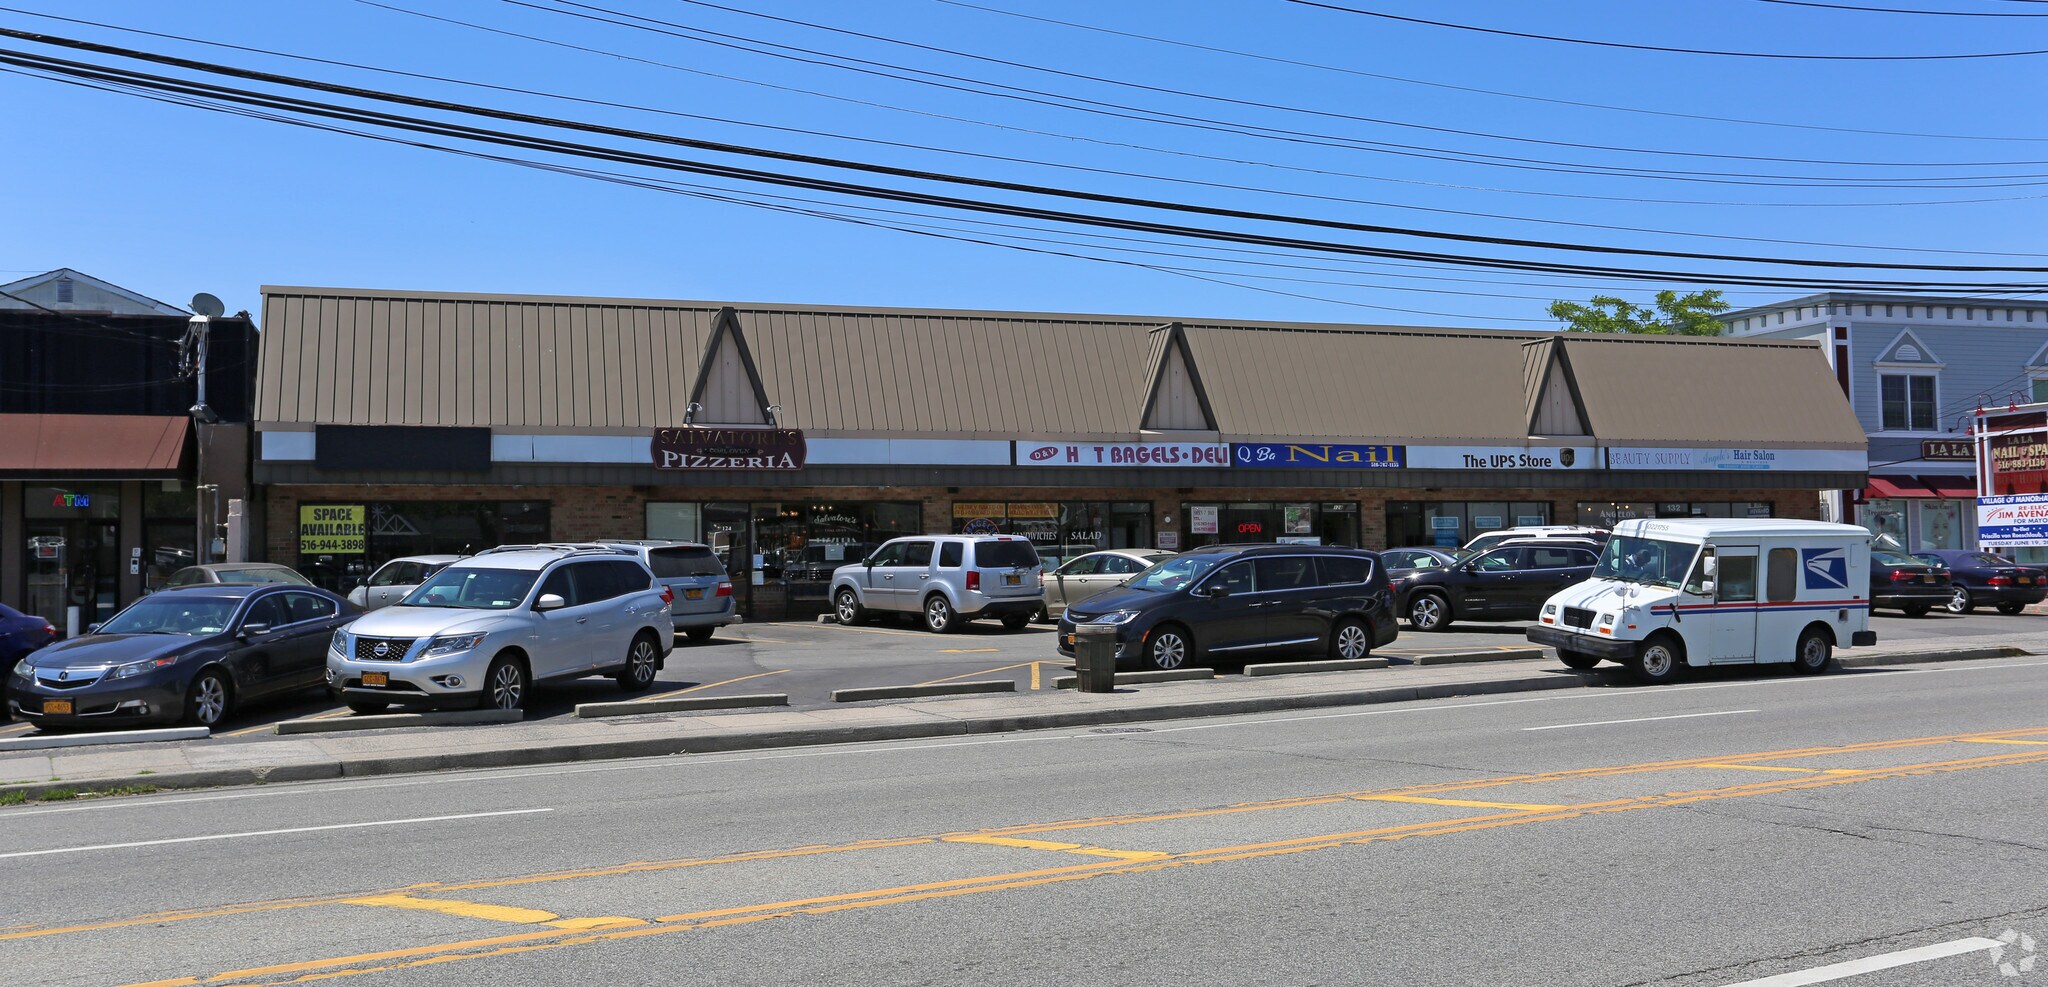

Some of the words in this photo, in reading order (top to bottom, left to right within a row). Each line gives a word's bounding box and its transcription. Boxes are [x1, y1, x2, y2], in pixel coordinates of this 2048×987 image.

[2007, 437, 2020, 445] LA
[2021, 435, 2034, 444] LA
[1034, 452, 1041, 460] D
[1048, 448, 1055, 456] V
[1111, 446, 1180, 464] BAGELS
[1191, 446, 1228, 464] DELI
[1237, 445, 1252, 463] Q
[1256, 446, 1276, 461] Ba
[1284, 445, 1398, 463] Nail
[1733, 449, 1752, 461] Hair
[1753, 449, 1775, 461] Salon
[1929, 443, 1949, 456] LA
[1993, 446, 2020, 459] NAIL
[2029, 443, 2048, 457] SPA
[661, 449, 797, 469] PIZZERIA
[1462, 454, 1487, 468] The
[1490, 454, 1516, 468] UPS
[1519, 453, 1552, 468] Store
[1609, 452, 1650, 465] BEAUTY
[1654, 452, 1691, 465] SUPPLY
[52, 494, 89, 507] ATM
[1981, 497, 2005, 505] VILLAGE
[2006, 496, 2015, 504] OF
[313, 508, 353, 521] SPACE
[1666, 504, 1681, 512] 132
[1997, 511, 2014, 519] JIM
[301, 523, 365, 536] AVAILABLE
[967, 520, 996, 534] BAGELS
[1237, 523, 1262, 533] OPEN
[1070, 531, 1102, 540] SALAD
[301, 539, 364, 550] 516-944-3898
